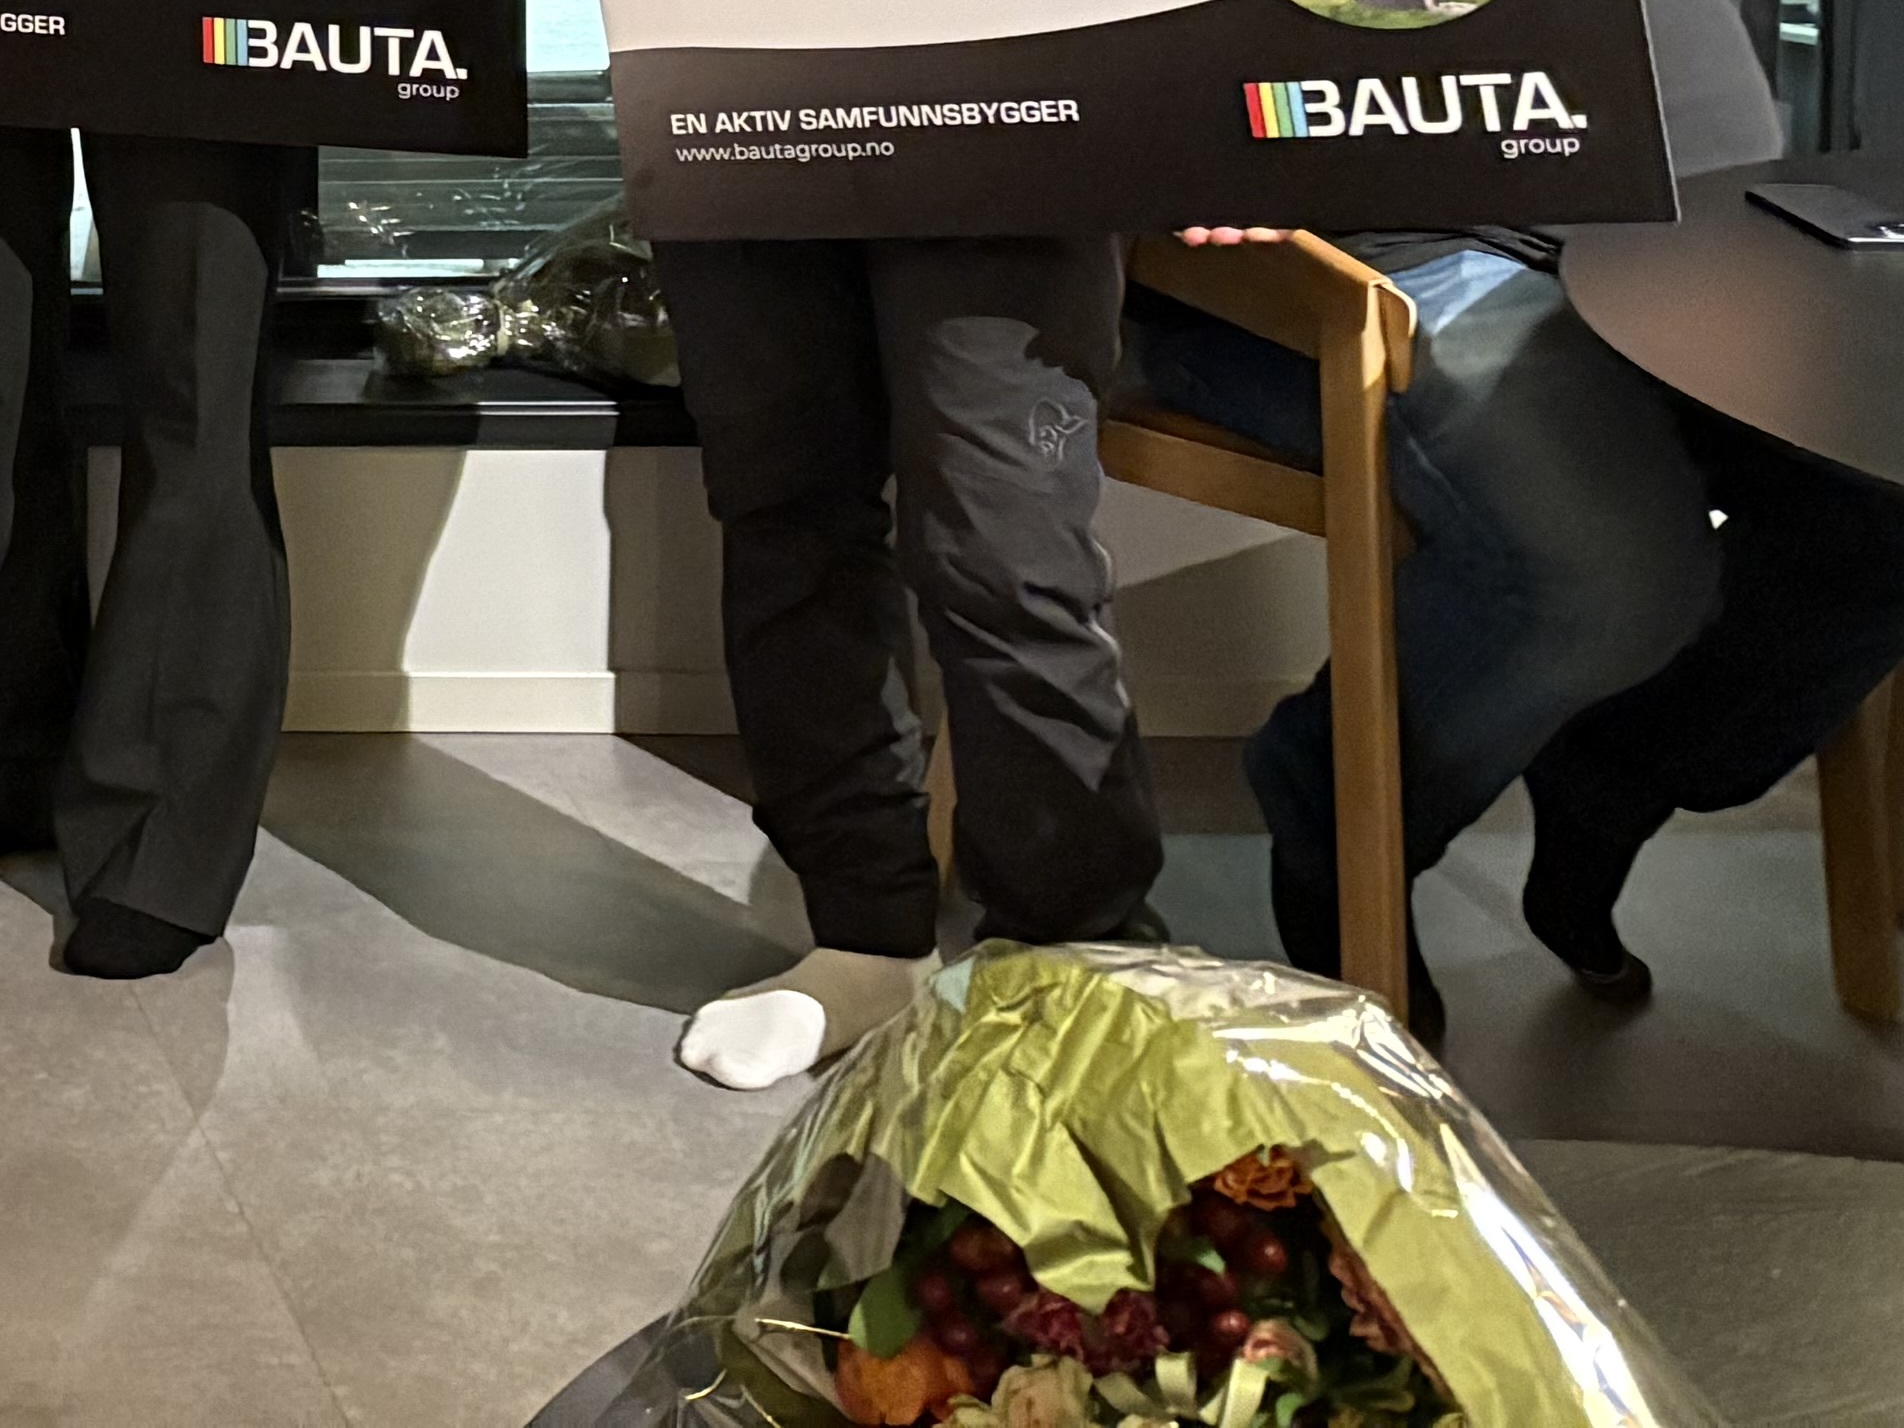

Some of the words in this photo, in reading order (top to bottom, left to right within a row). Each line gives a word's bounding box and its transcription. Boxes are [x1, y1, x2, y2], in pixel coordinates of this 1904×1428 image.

[397, 82, 460, 101] group
[670, 112, 708, 135] EN
[714, 109, 792, 134] AKTIV
[798, 99, 1080, 131] SAMFUNNSBYGGER
[675, 141, 895, 163] www.bautagroup.no
[1500, 137, 1581, 159] group
